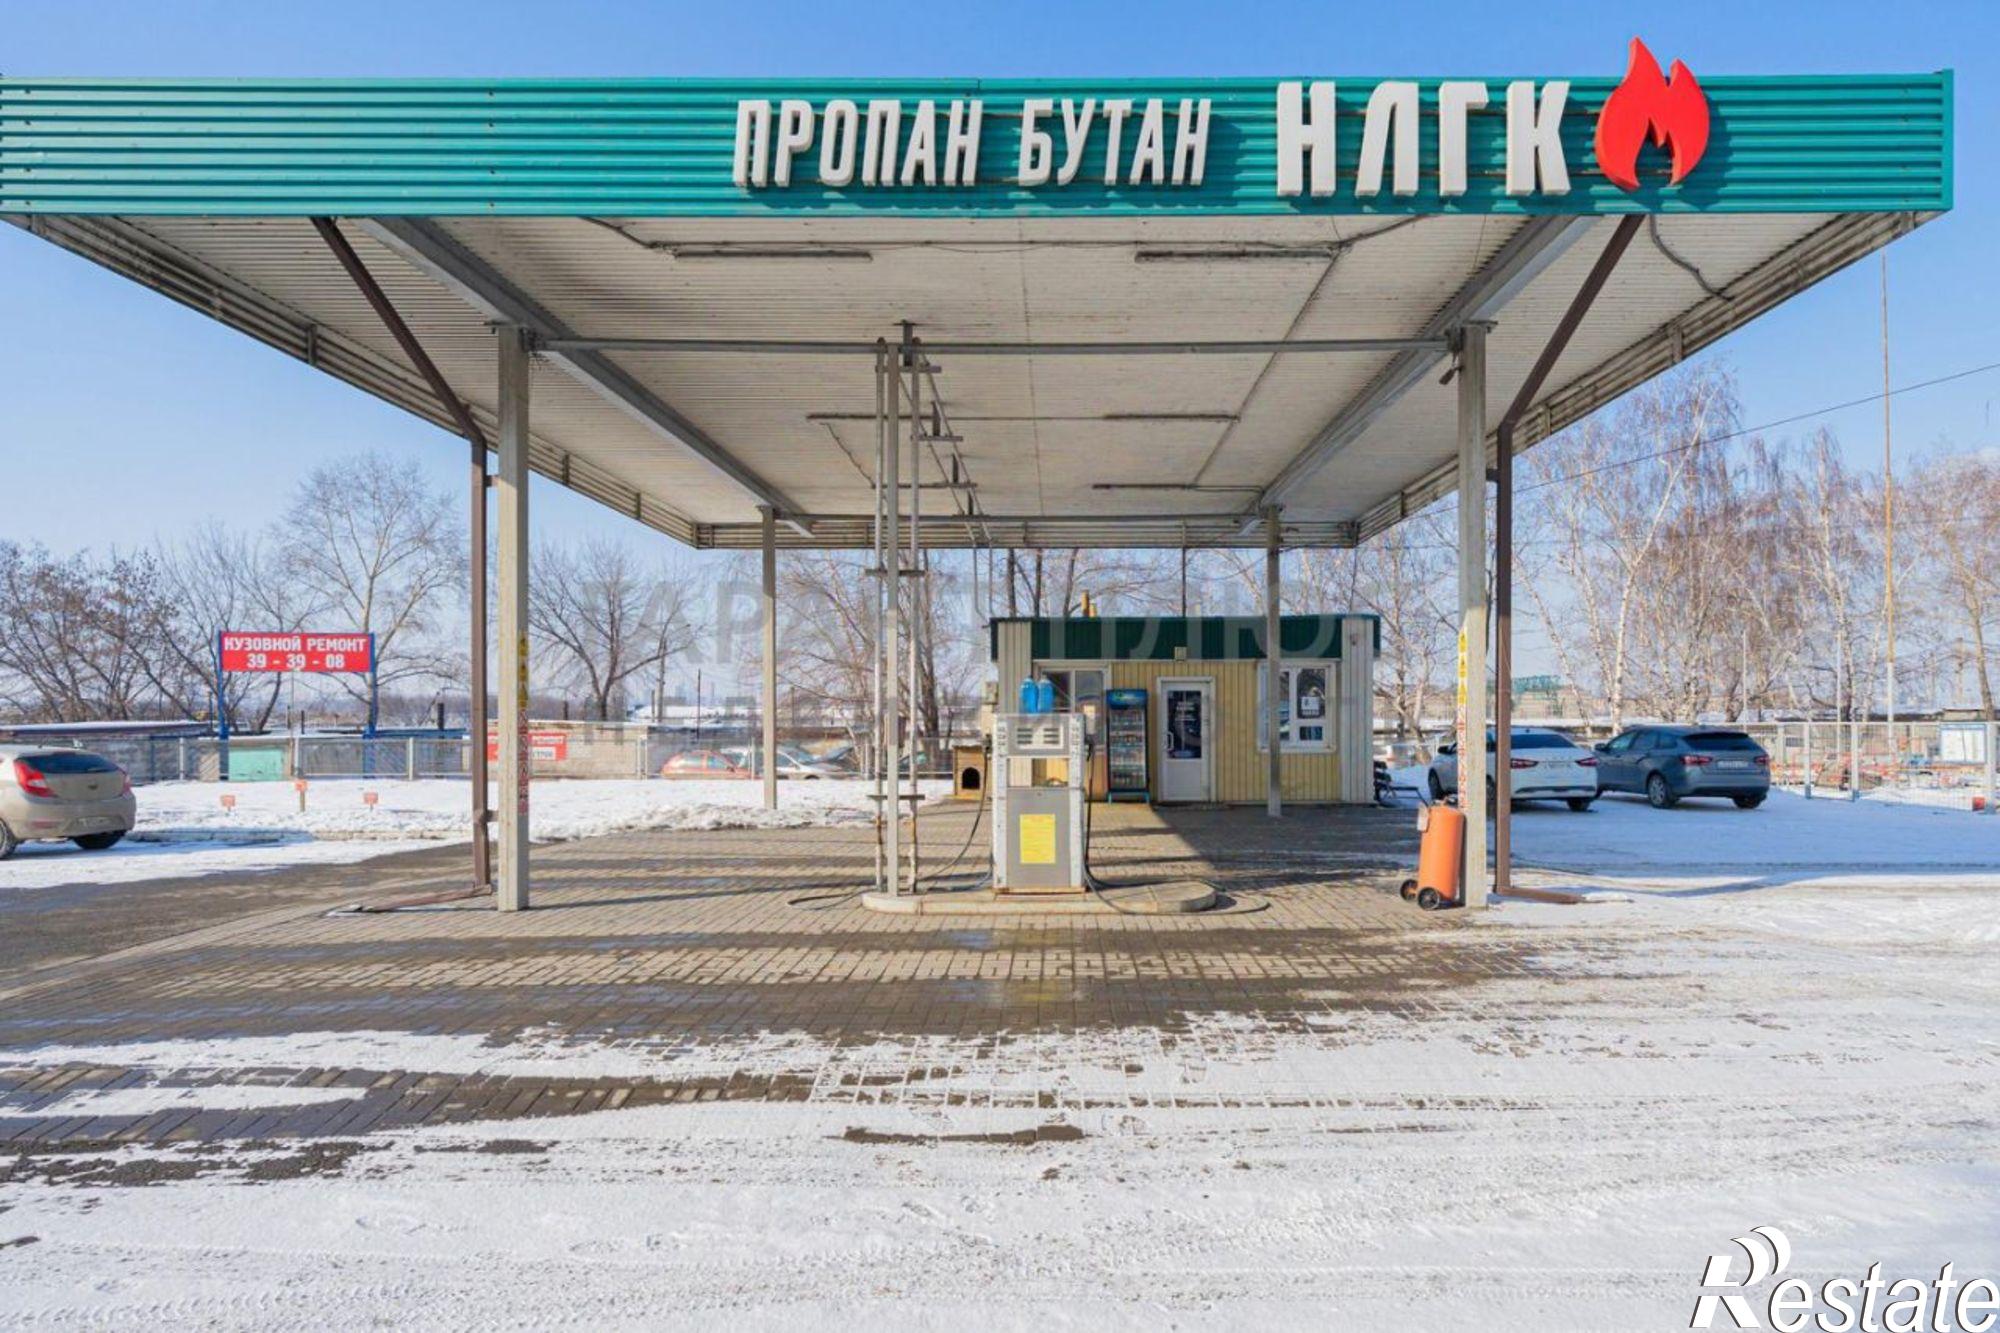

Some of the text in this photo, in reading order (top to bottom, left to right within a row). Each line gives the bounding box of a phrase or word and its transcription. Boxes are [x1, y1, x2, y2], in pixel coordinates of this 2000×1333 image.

[732, 80, 1571, 197] ПРОПАН БУТАН НЛГК
[224, 636, 367, 651] КУЗОВНОЙ РЕМОНТ
